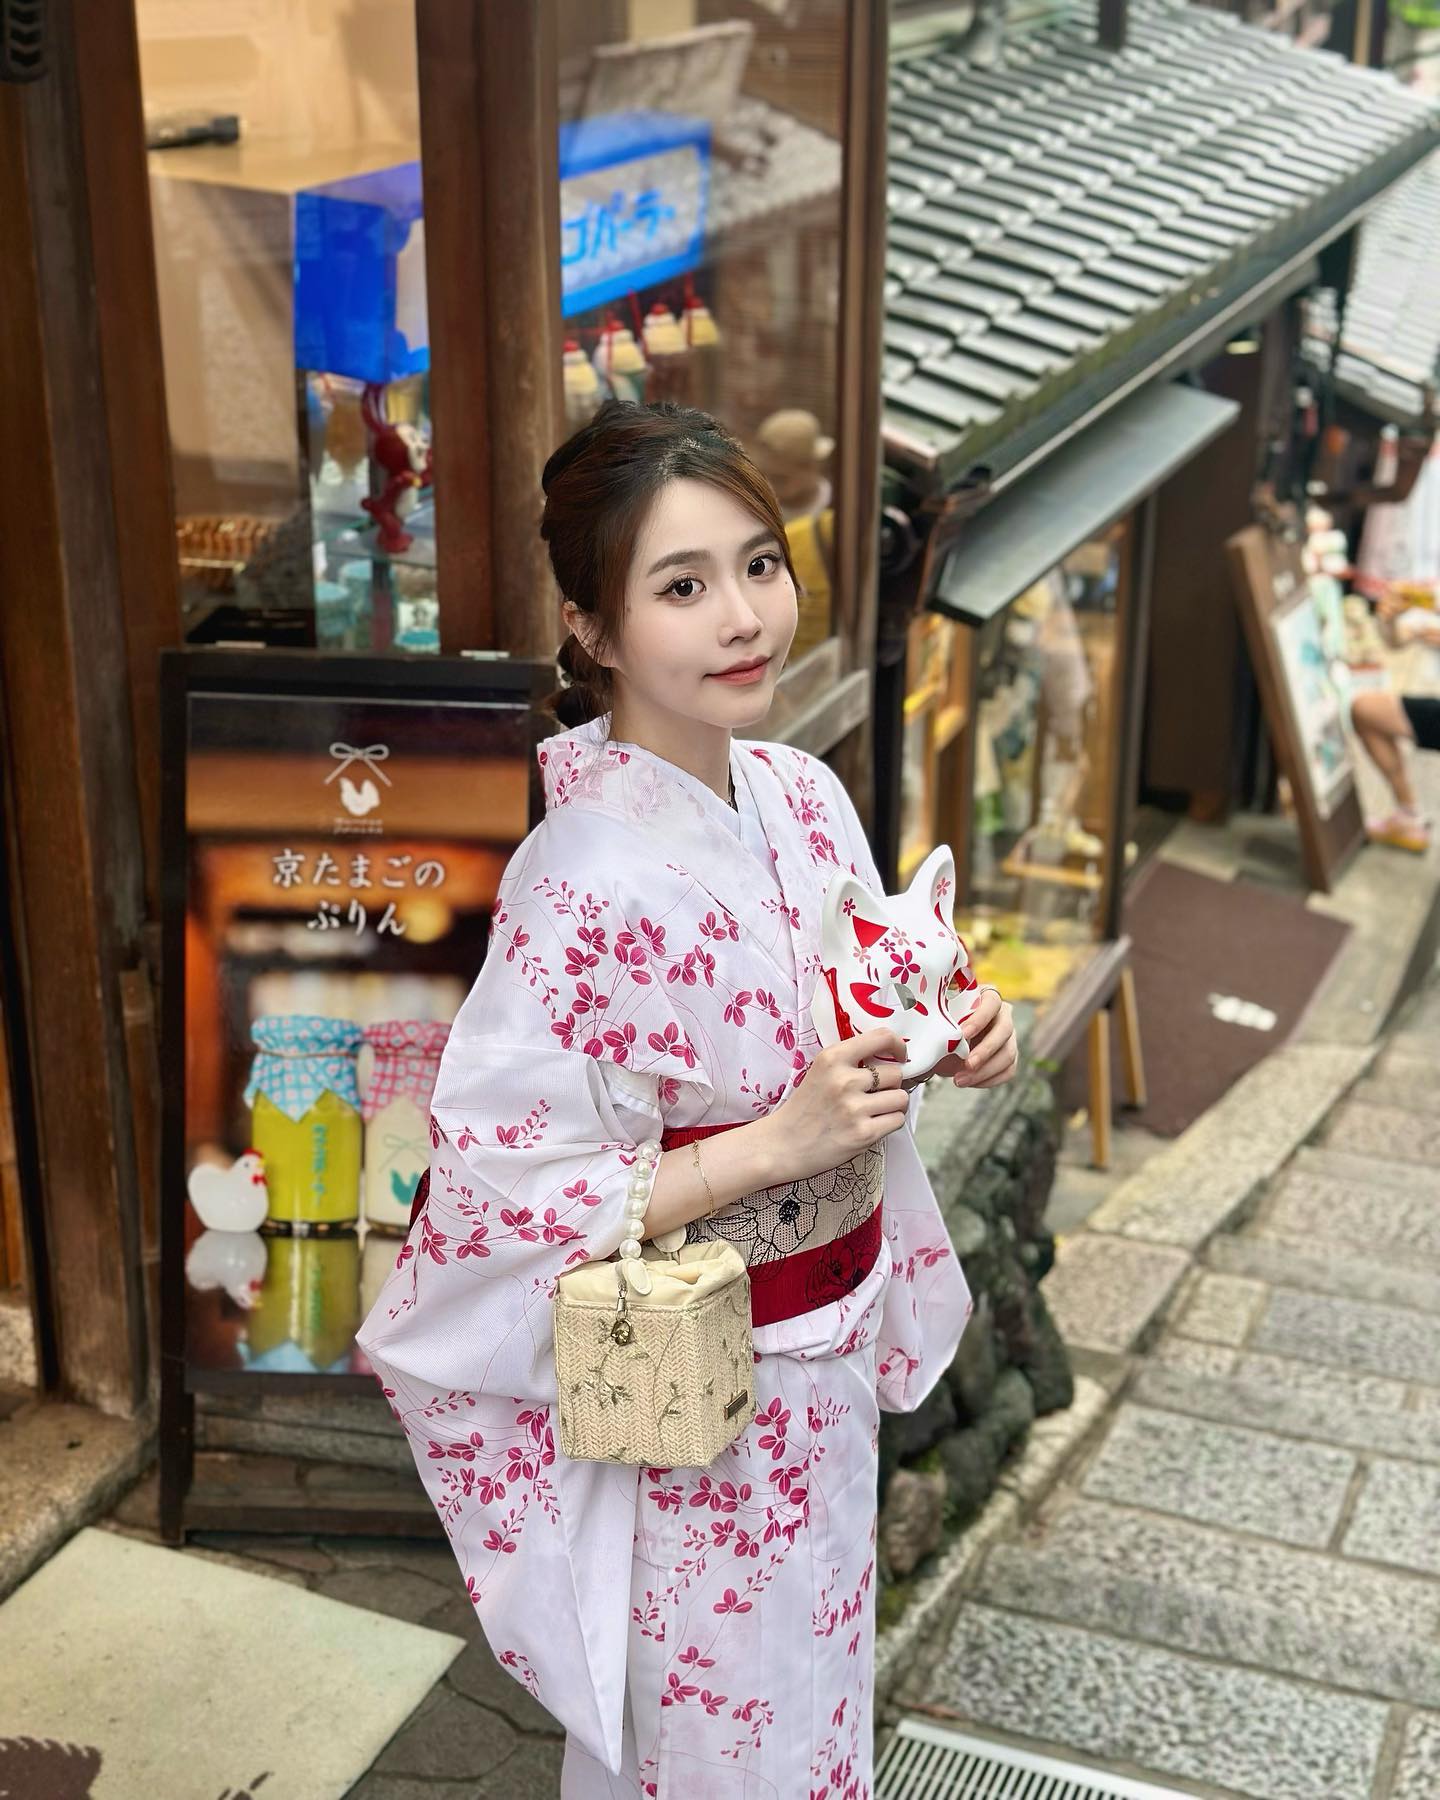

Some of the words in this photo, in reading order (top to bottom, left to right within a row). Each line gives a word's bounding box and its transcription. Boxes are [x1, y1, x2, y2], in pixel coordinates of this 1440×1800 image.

[273, 848, 446, 888] 京たまごの
